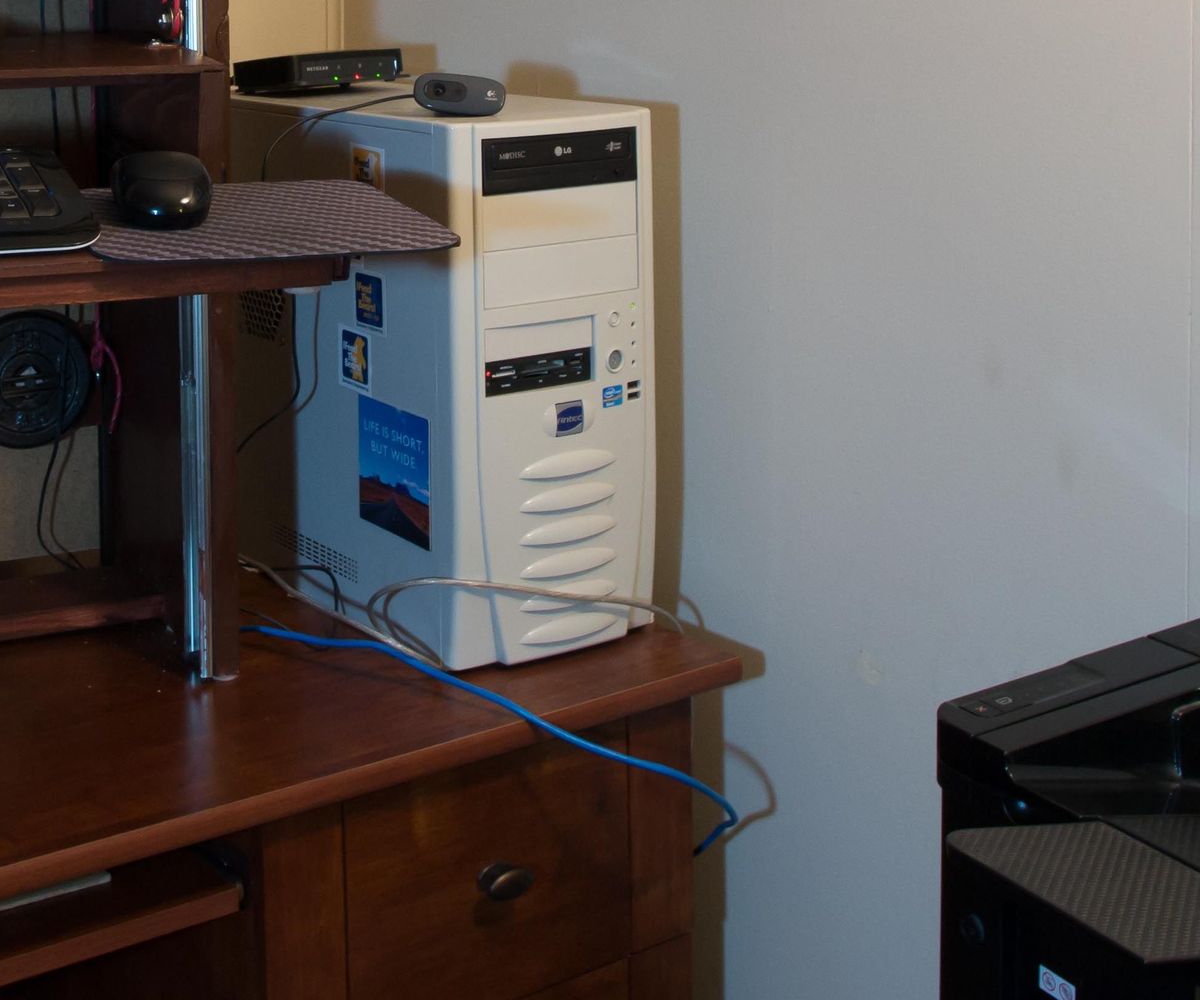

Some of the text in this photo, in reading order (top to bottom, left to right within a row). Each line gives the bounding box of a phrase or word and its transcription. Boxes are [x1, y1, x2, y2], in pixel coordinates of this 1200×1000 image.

[363, 419, 425, 454] LIFE IS SHORT,
[370, 439, 417, 470] BUT WIDE
